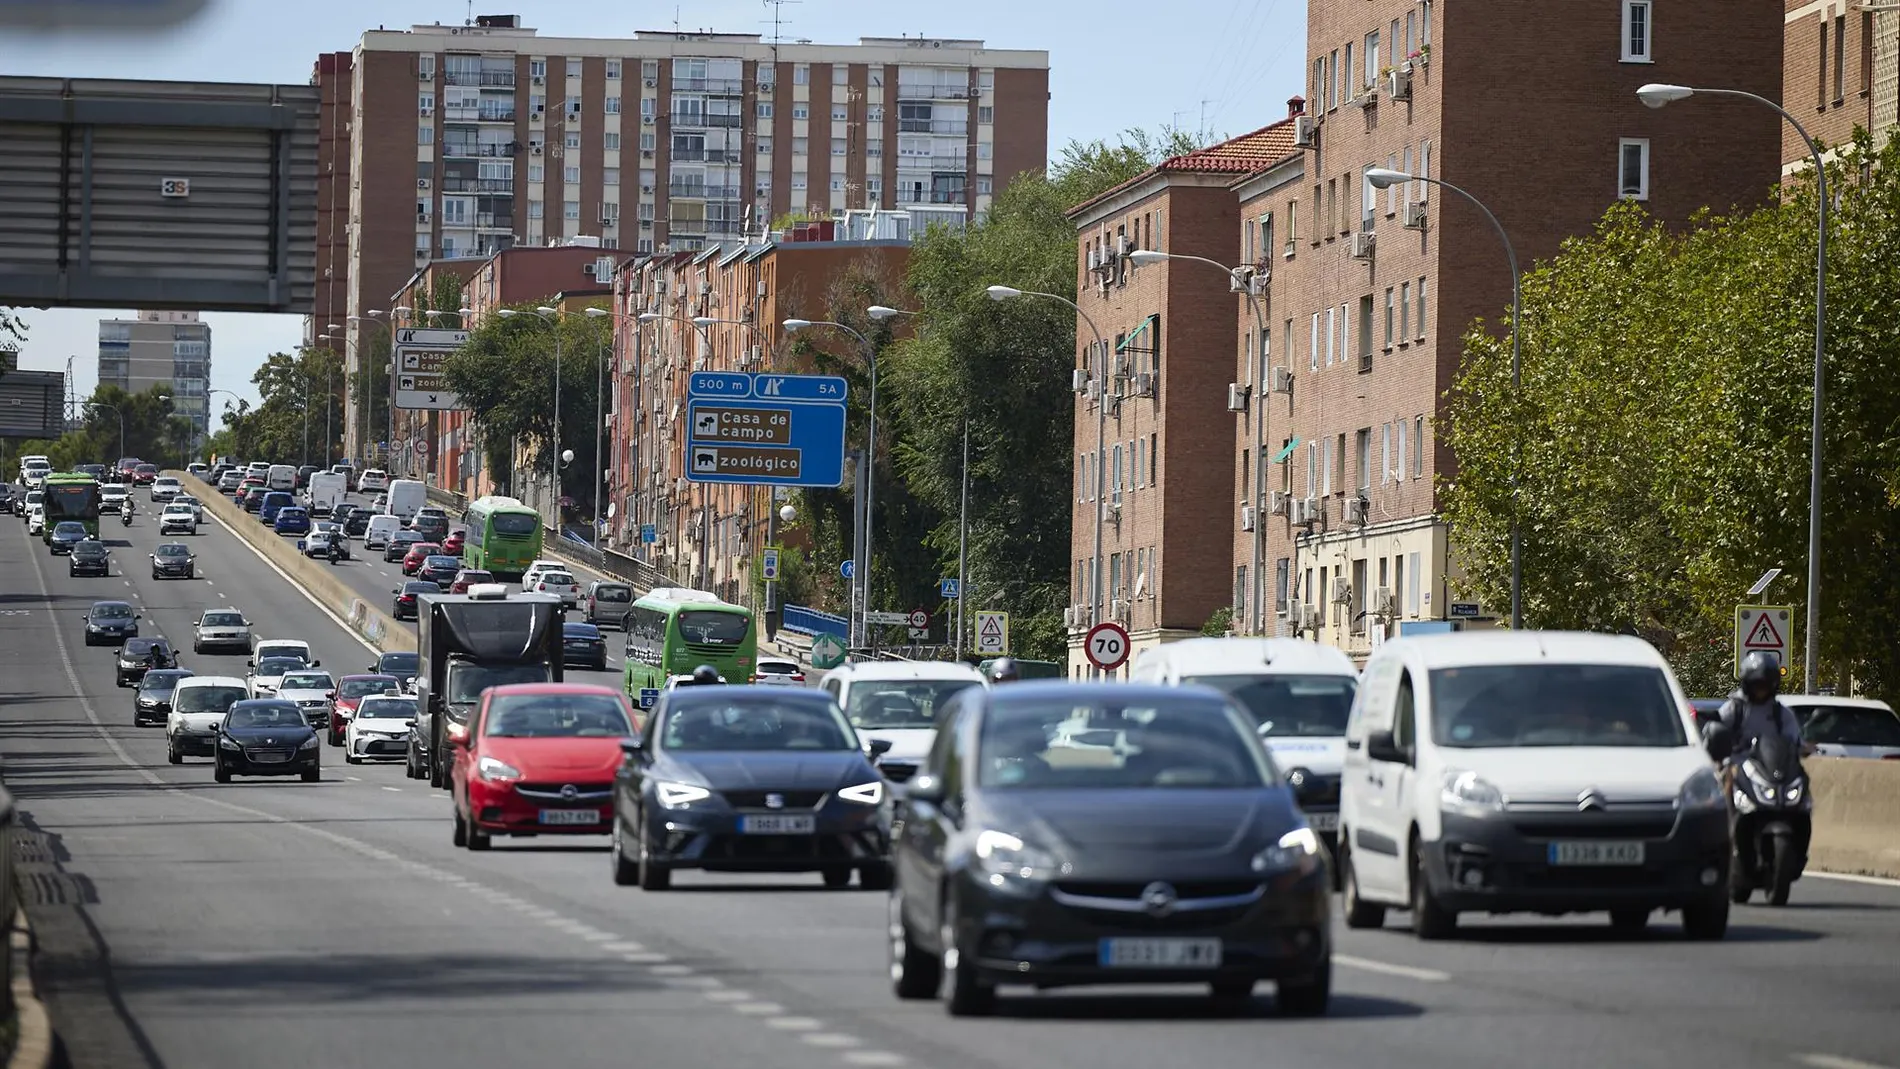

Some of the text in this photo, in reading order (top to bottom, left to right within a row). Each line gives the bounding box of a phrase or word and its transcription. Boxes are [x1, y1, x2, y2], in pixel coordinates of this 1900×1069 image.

[164, 180, 186, 194] 3S
[421, 352, 446, 360] Casa
[698, 379, 743, 390] 500 m
[819, 384, 837, 394] 5A
[721, 411, 787, 426] Casa de
[721, 427, 774, 441] campo
[720, 455, 798, 472] zoológico
[913, 615, 926, 623] 40
[1095, 638, 1120, 654] 70
[646, 697, 653, 706] 8
